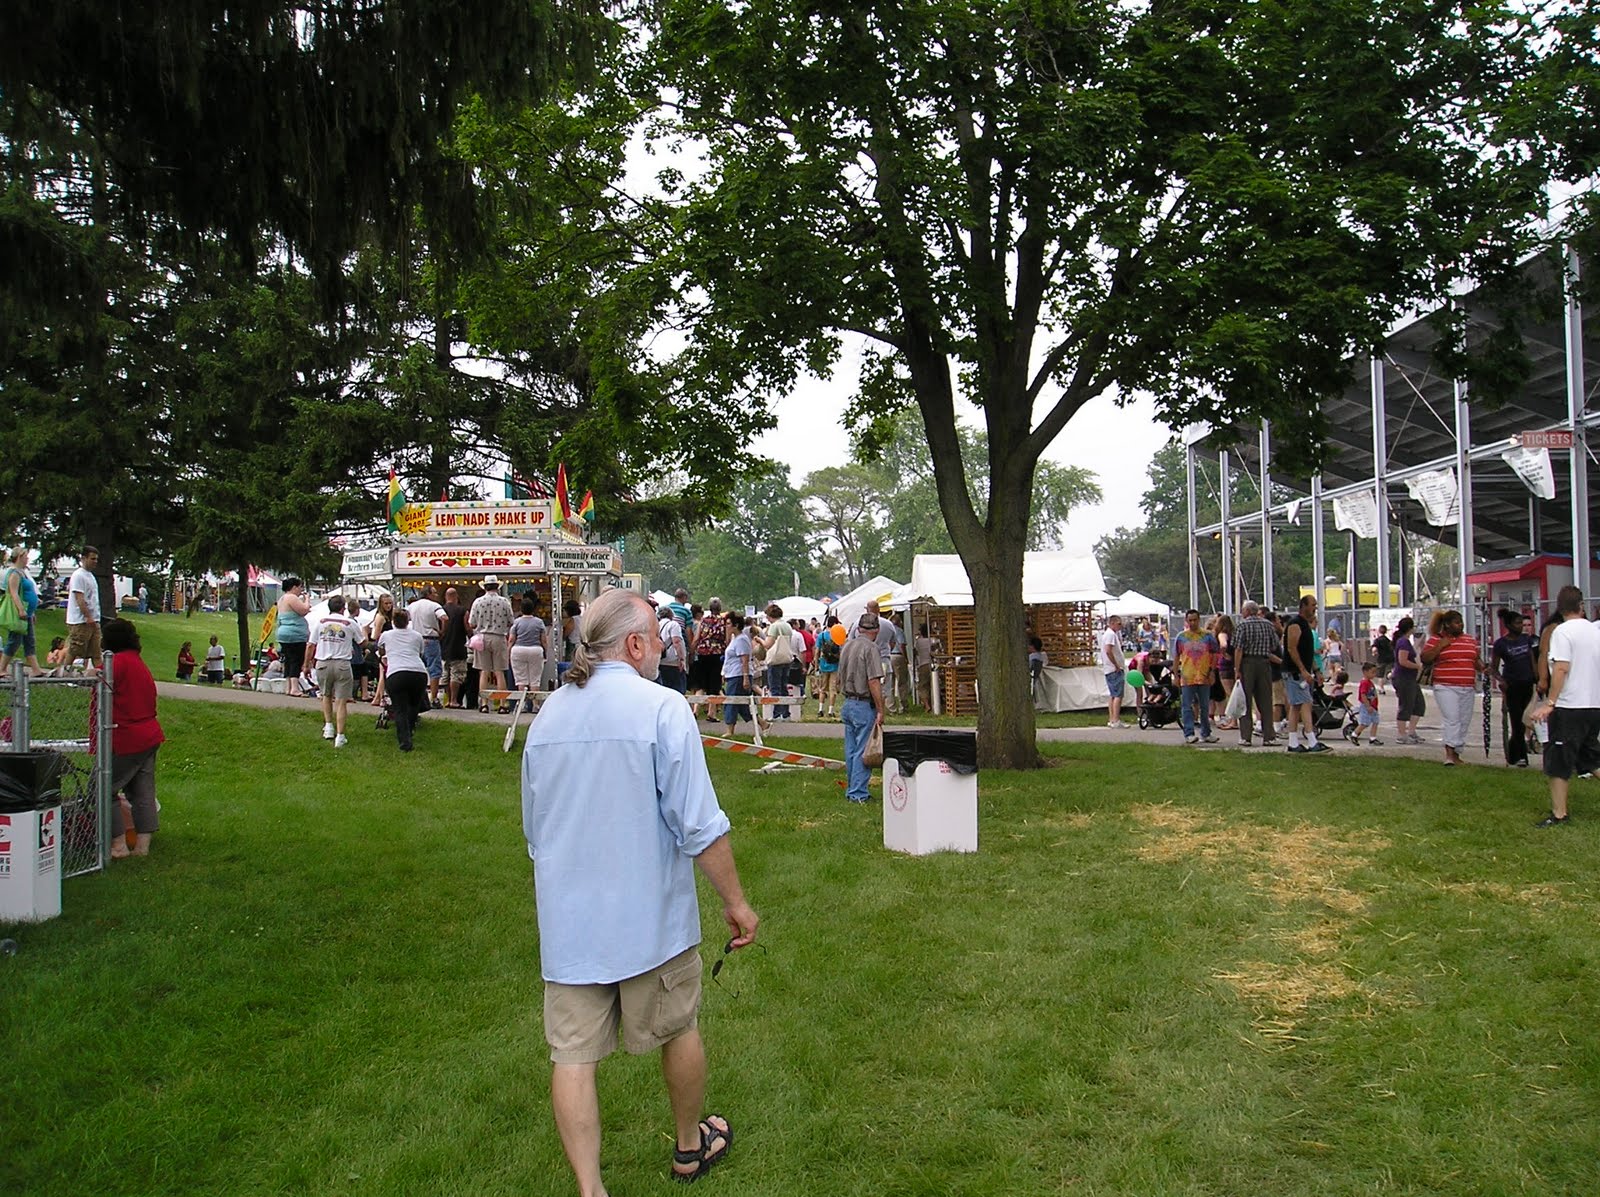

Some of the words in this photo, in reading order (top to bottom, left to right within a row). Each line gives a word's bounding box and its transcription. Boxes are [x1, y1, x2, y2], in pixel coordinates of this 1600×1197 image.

[1524, 434, 1570, 444] TICKETS
[405, 510, 426, 522] GIANT
[495, 512, 527, 525] SHAKE
[531, 511, 545, 524] UP
[406, 550, 533, 558] STRAWBERRY-LEMON
[549, 551, 589, 561] Community
[590, 552, 610, 560] Grace
[553, 560, 585, 570] Brethren
[585, 561, 606, 569] Youth
